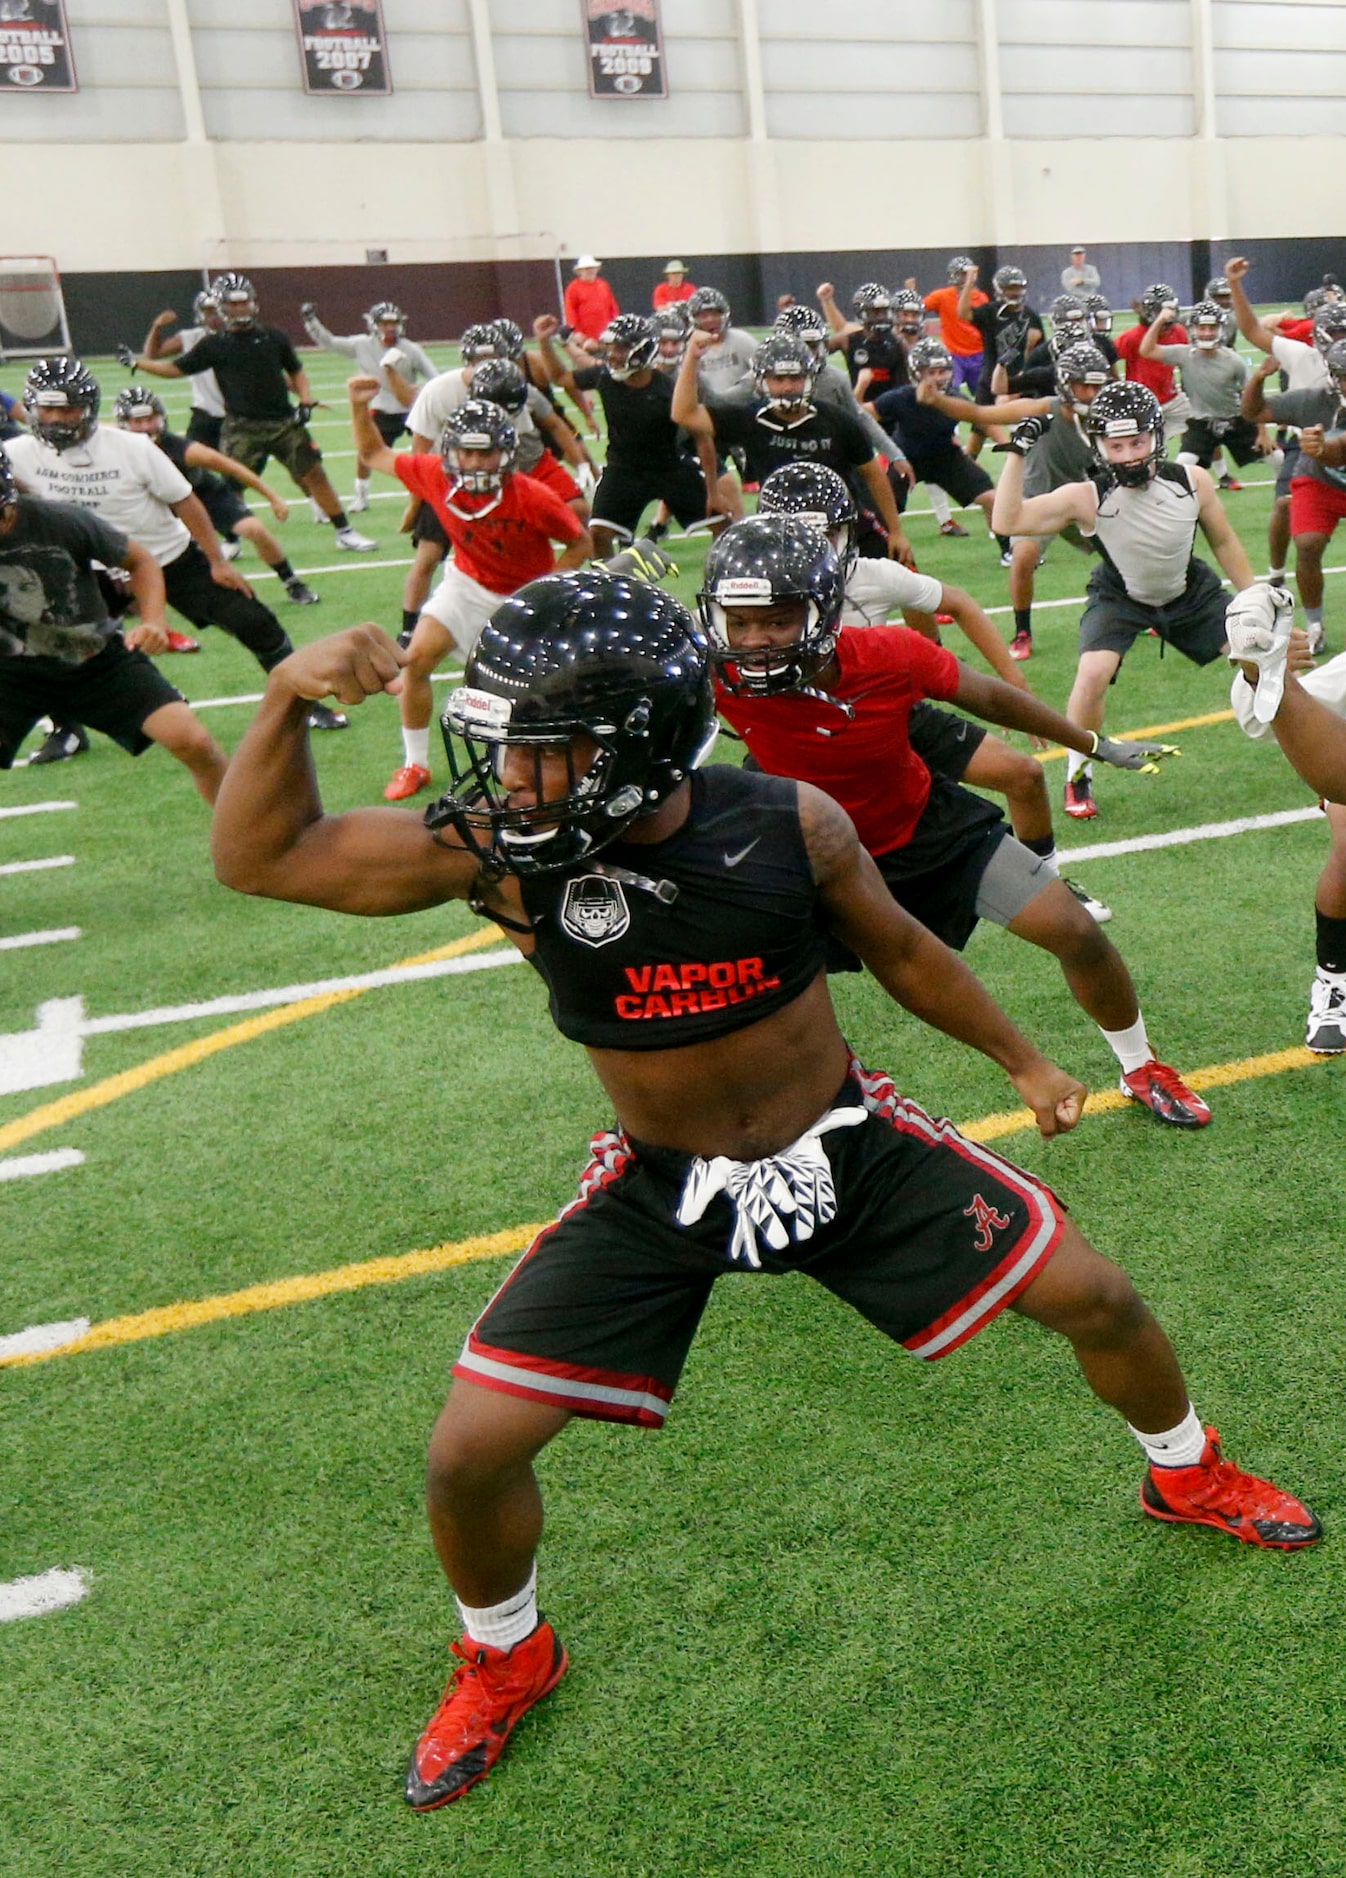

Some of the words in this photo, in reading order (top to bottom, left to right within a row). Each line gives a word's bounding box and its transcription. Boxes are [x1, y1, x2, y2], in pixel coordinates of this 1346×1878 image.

[304, 36, 380, 51] FOOTBALL
[592, 43, 659, 58] FOOTBALL
[0, 45, 55, 64] 2005
[316, 51, 372, 69] 2007
[769, 434, 798, 449] JUST
[48, 482, 110, 497] FOOTBALL
[730, 581, 759, 590] Riddell
[624, 956, 764, 993] VAPOR
